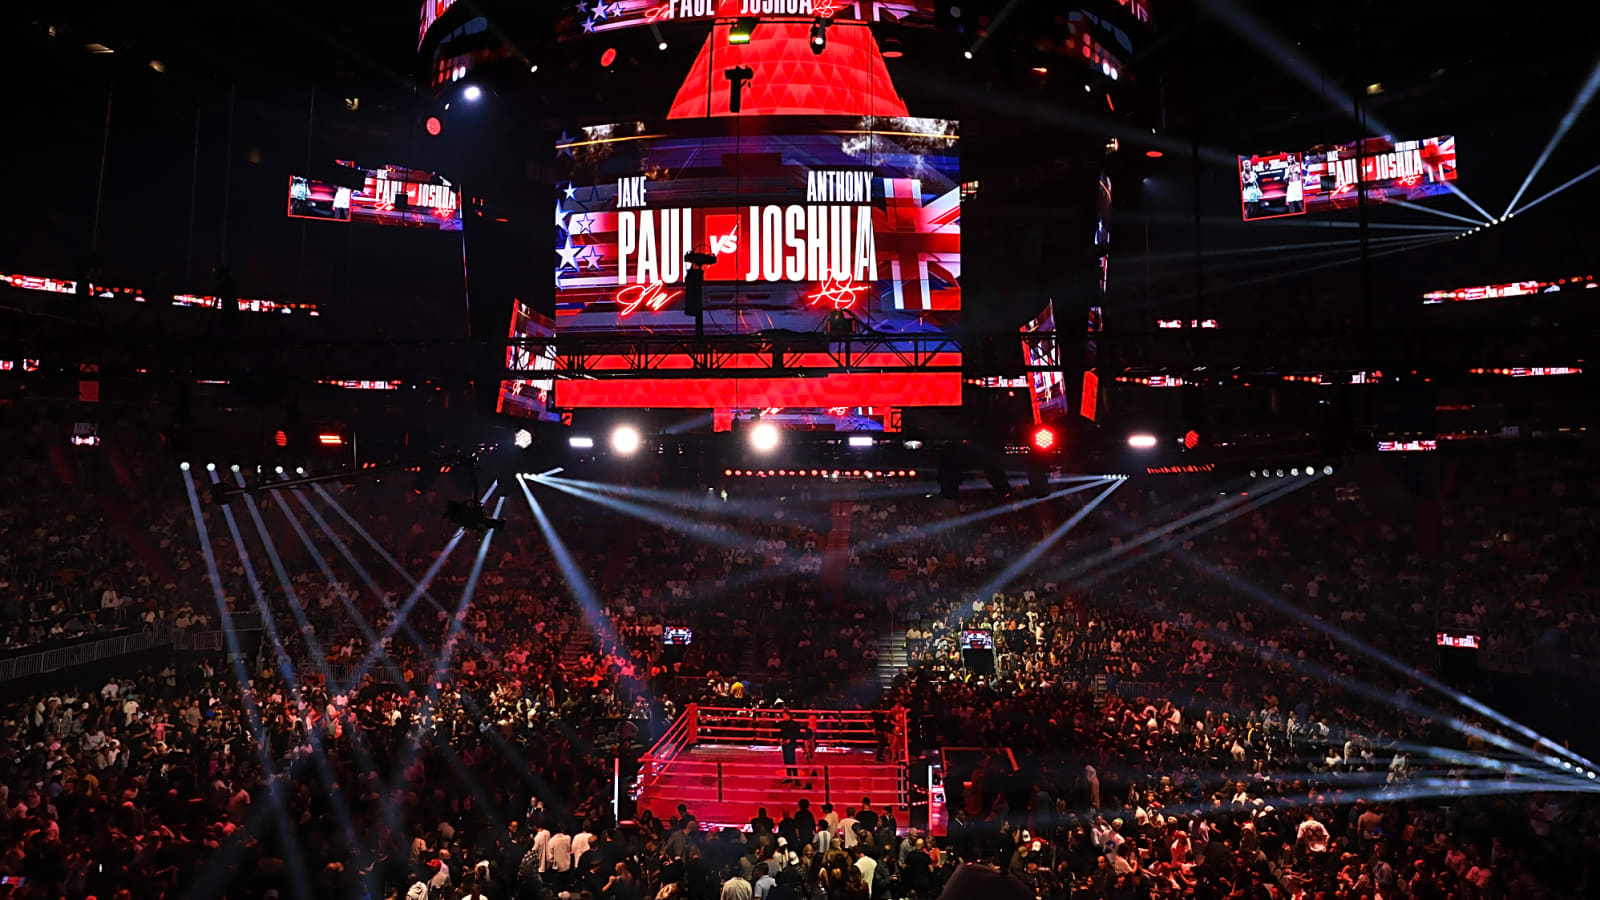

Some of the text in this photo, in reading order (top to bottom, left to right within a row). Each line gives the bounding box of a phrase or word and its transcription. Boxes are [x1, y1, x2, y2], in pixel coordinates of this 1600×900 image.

[1375, 150, 1424, 180] JOSHUA
[416, 183, 457, 210] JOSHUA
[617, 176, 647, 208] JAKE
[807, 171, 873, 202] ANTHONY
[618, 208, 693, 285] PAUL
[746, 205, 879, 281] JOSHUA
